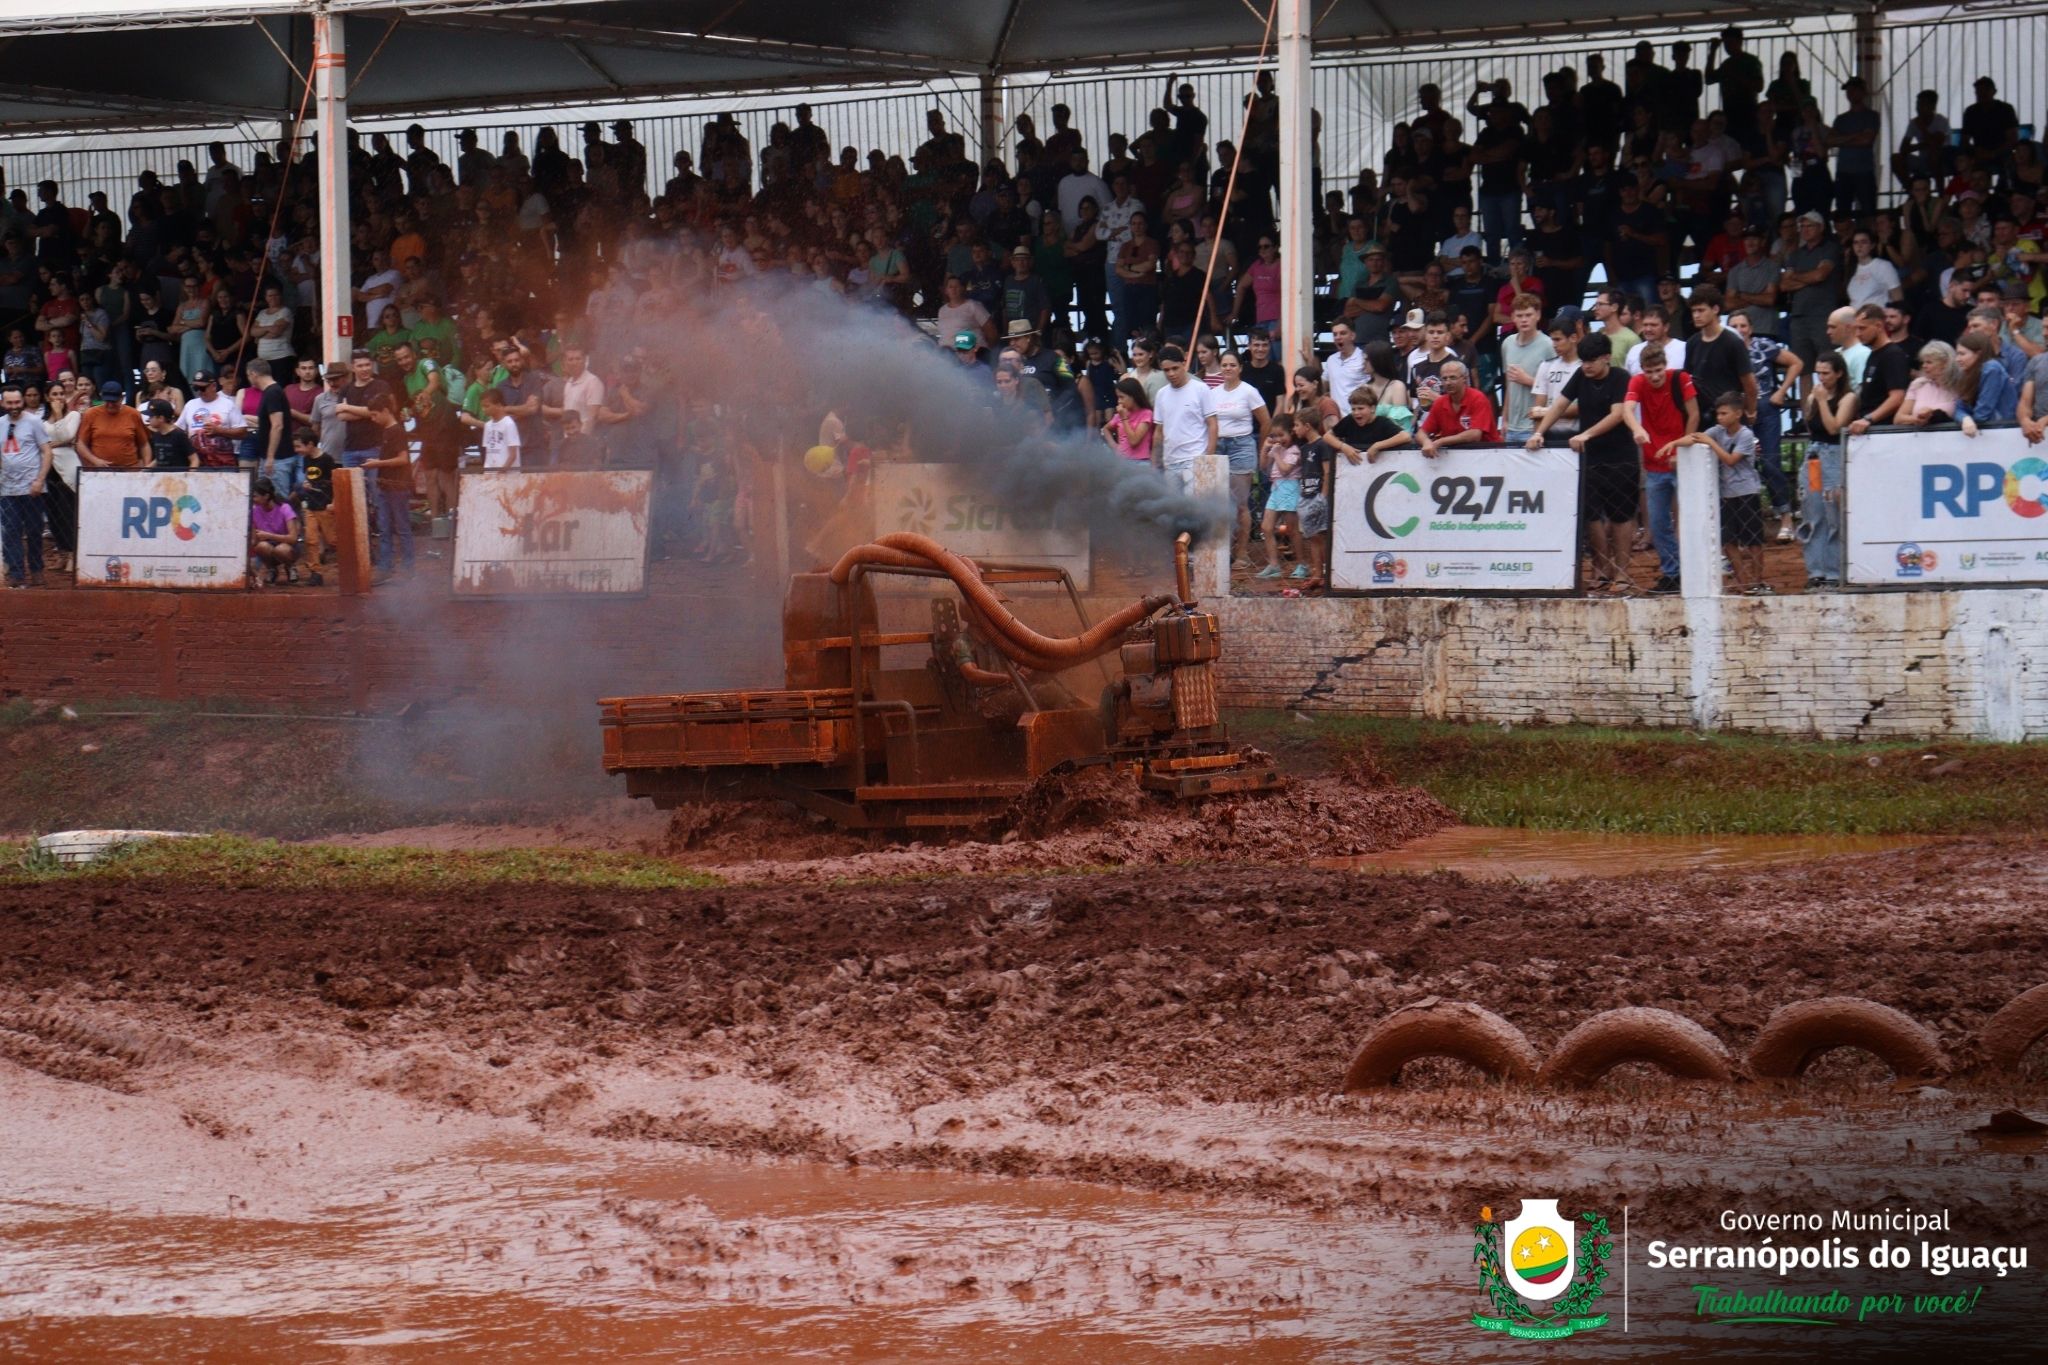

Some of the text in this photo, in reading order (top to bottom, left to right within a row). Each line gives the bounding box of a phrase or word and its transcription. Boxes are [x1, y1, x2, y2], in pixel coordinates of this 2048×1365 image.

[1507, 490, 1545, 514] FM
[1921, 457, 2048, 519] RPC
[121, 495, 202, 541] RPC
